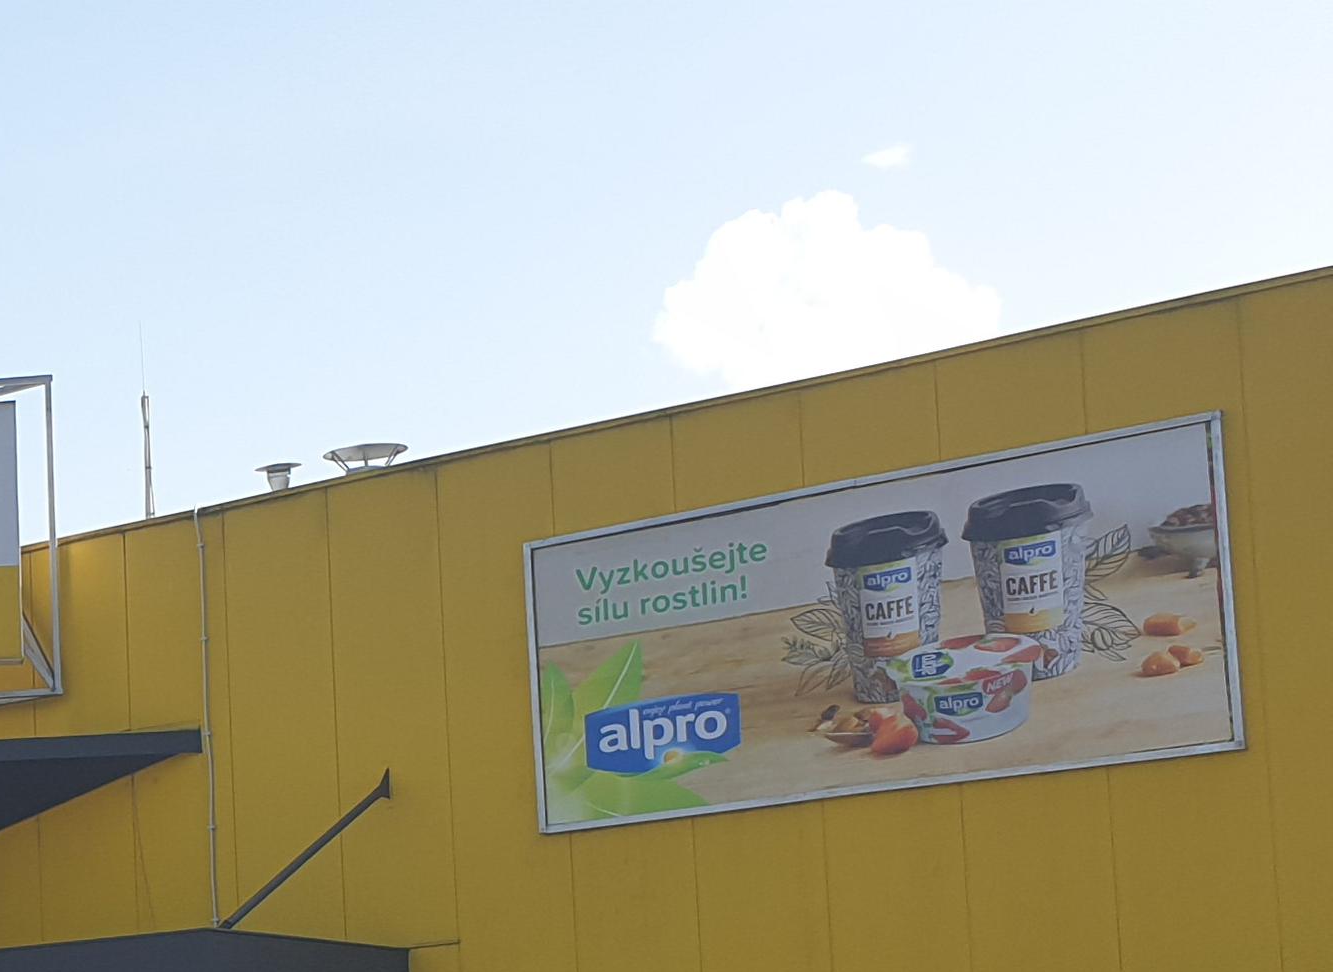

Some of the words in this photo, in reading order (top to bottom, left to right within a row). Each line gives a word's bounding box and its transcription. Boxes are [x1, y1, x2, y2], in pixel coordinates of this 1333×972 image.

[575, 539, 768, 596] Vyzkoušejte
[1008, 545, 1052, 561] alpro
[867, 571, 909, 589] alpro
[577, 592, 630, 627] sílu
[638, 575, 749, 617] rostlin!
[939, 696, 979, 712] alpro
[598, 708, 728, 760] alpro
